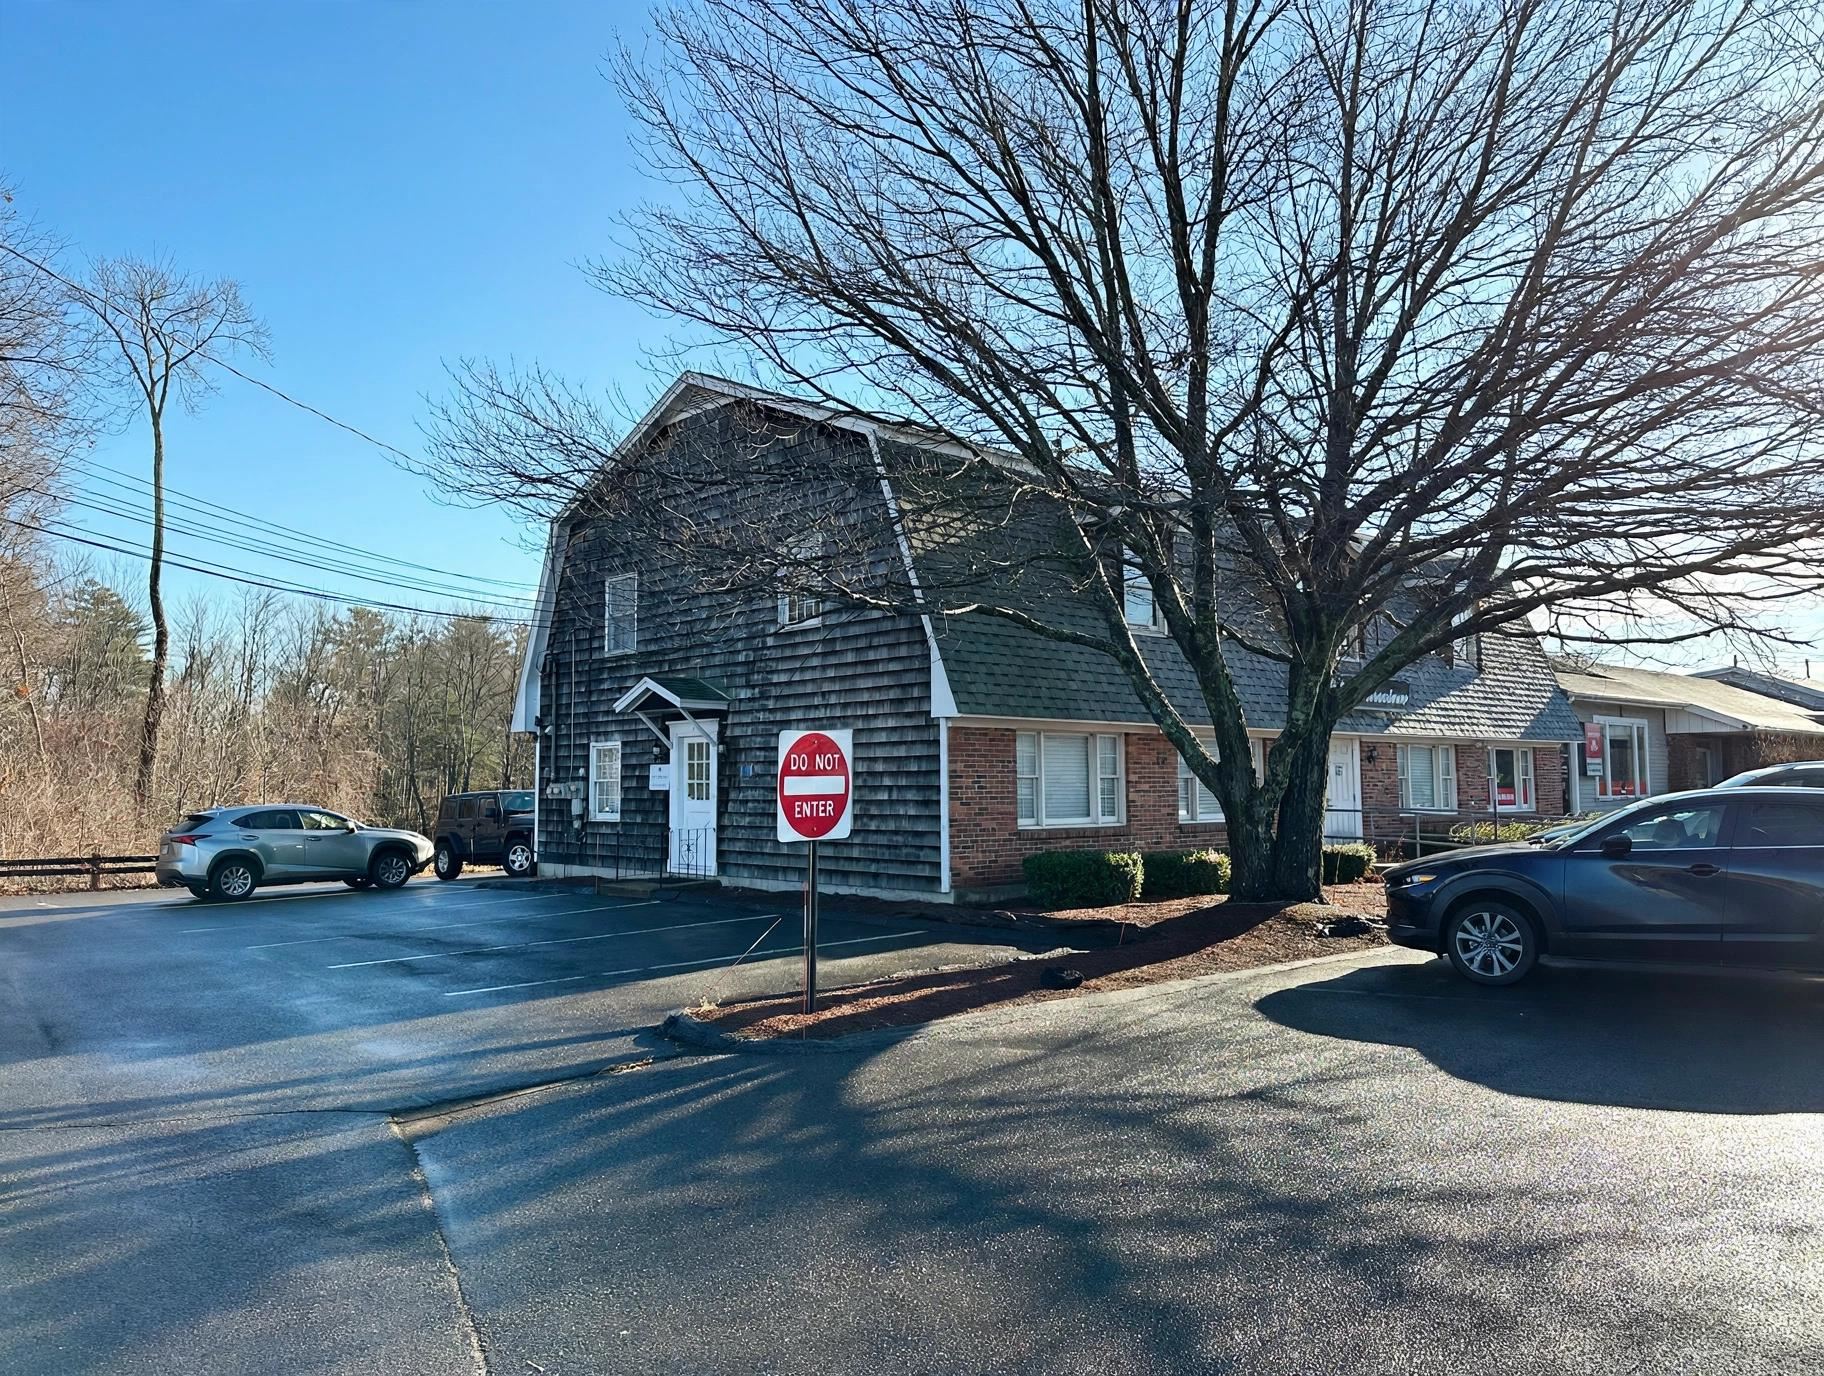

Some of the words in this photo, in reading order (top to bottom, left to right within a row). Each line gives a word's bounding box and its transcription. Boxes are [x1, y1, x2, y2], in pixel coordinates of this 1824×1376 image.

[790, 754, 808, 770] DO
[815, 753, 840, 770] NOT
[794, 800, 834, 818] ENTER
